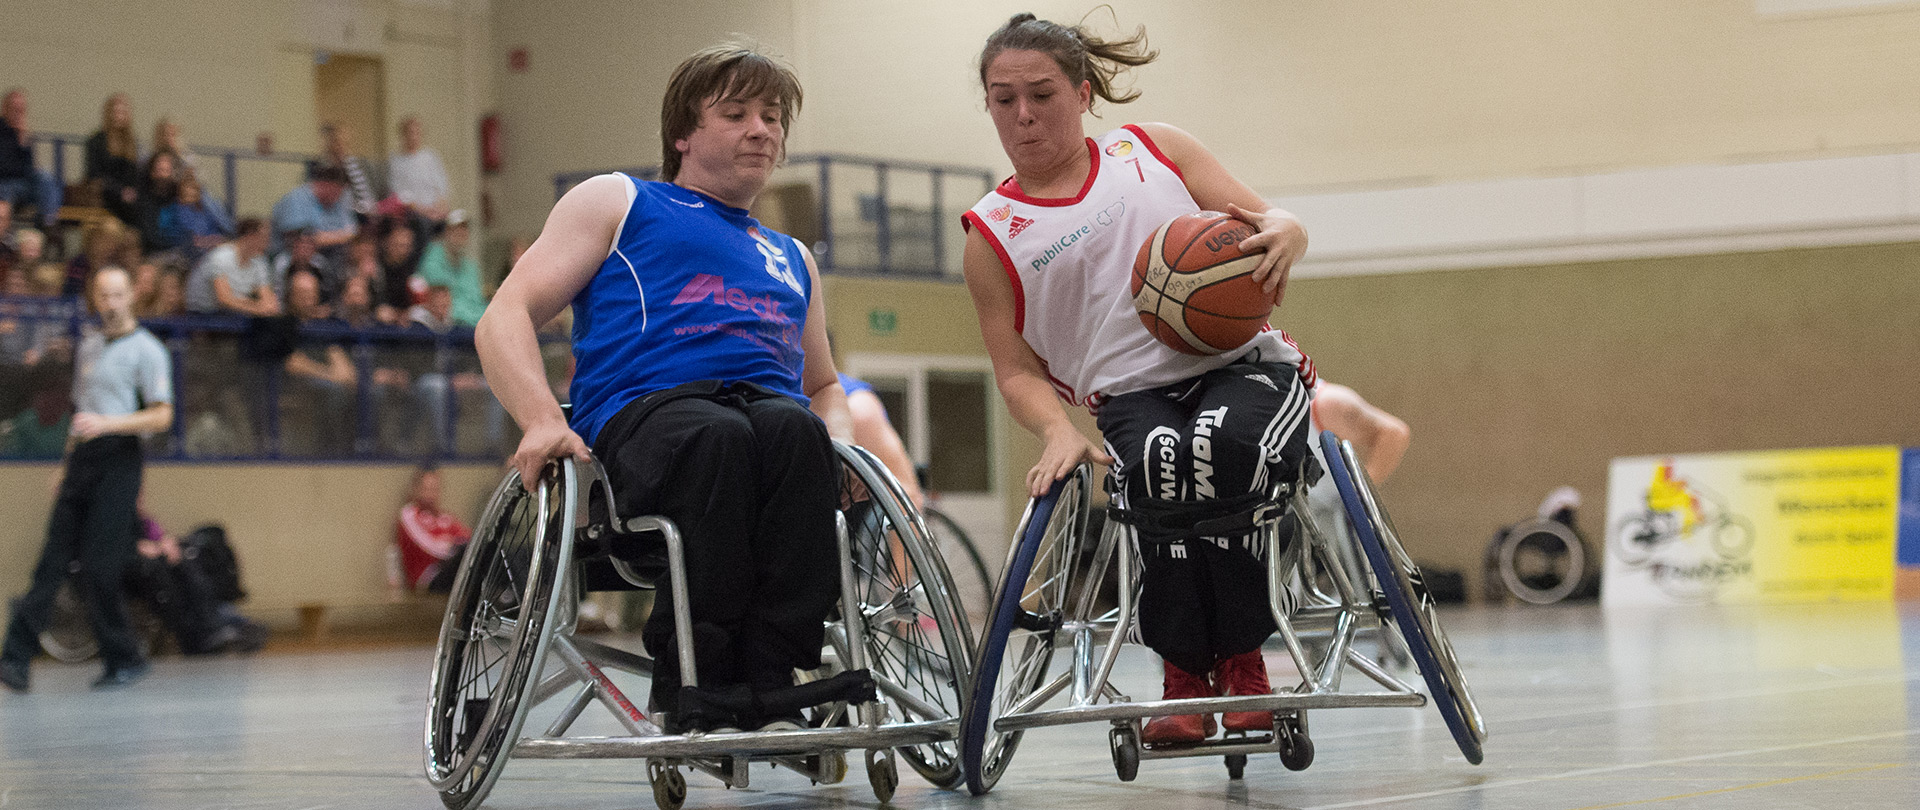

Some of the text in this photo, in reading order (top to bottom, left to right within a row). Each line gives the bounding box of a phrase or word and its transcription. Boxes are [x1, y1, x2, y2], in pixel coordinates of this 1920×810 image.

[1124, 157, 1145, 183] 7
[1008, 218, 1035, 240] adidas
[1031, 225, 1091, 272] PubliCare
